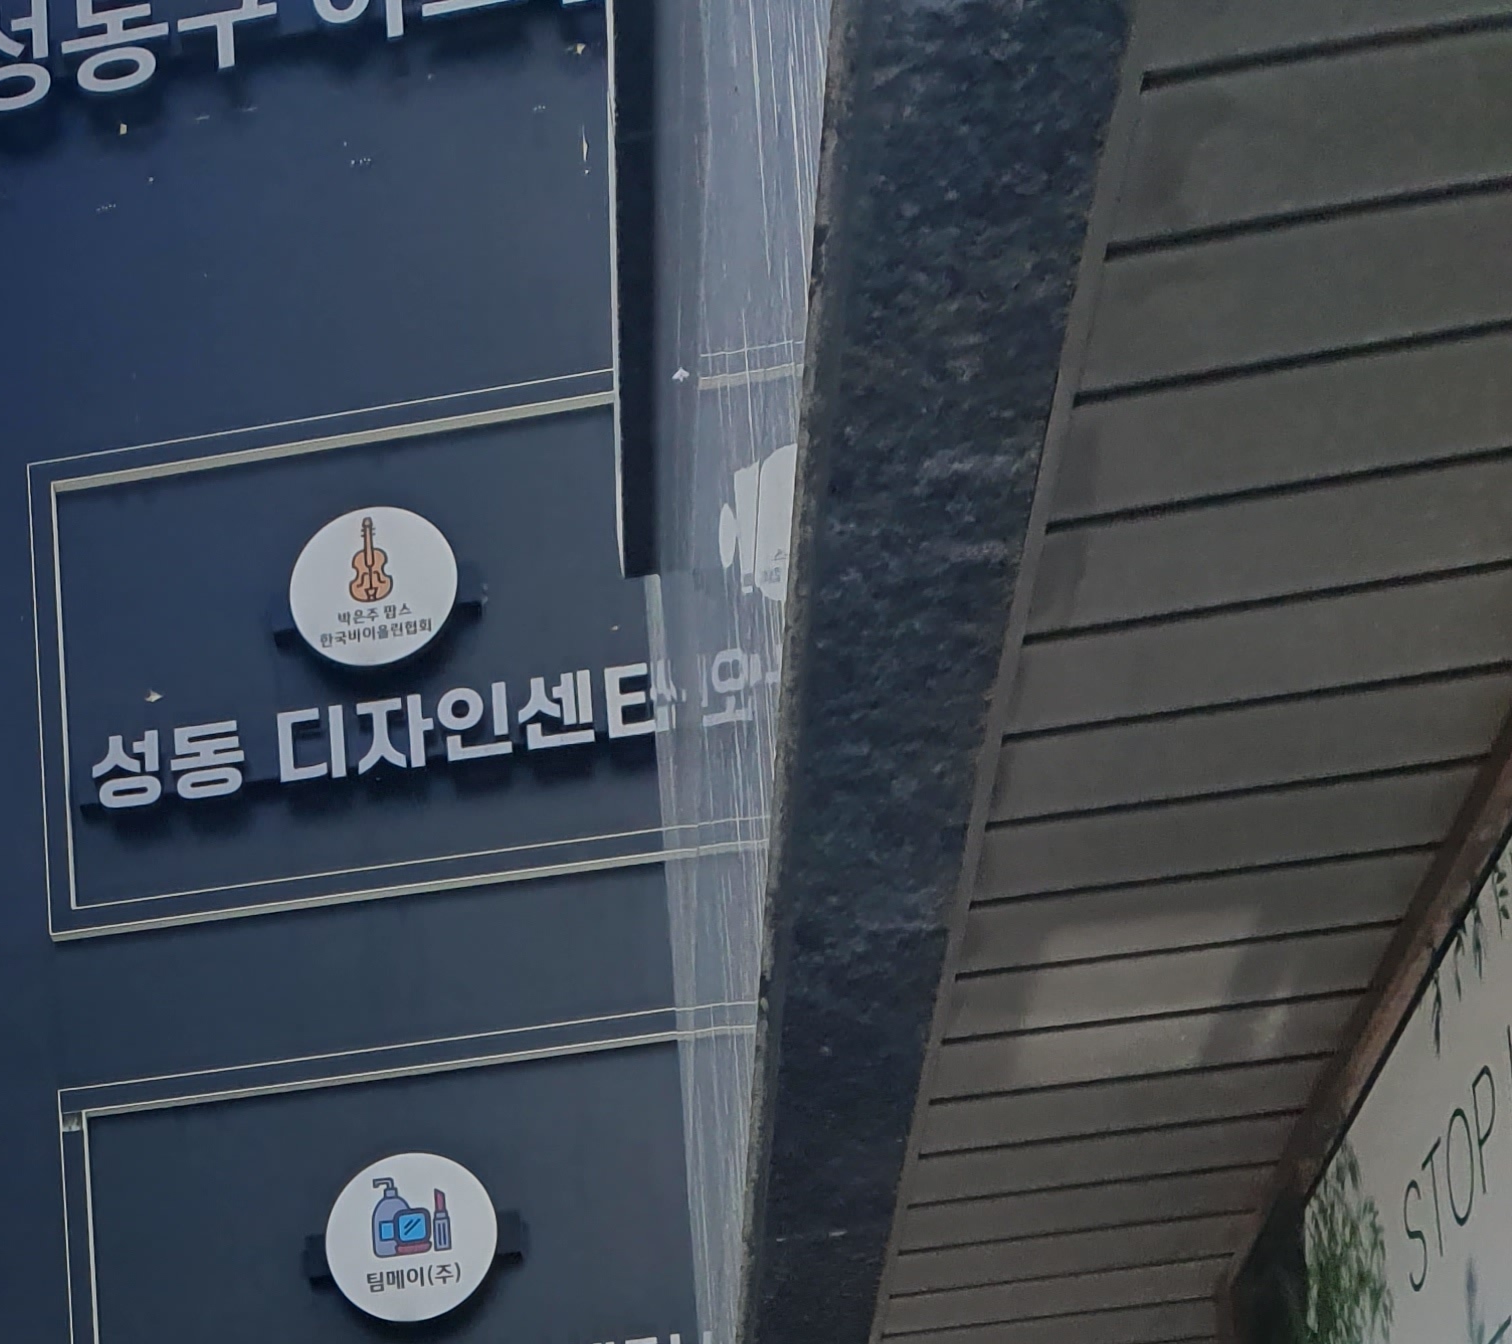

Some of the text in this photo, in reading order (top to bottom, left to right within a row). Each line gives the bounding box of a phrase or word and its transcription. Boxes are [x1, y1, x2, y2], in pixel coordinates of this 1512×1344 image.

[337, 607, 380, 626] 박은주
[90, 717, 246, 810] 성동
[275, 657, 678, 784] 디자인센터
[1402, 1064, 1496, 1292] STOP
[366, 1261, 462, 1294] 팀메이(주)
